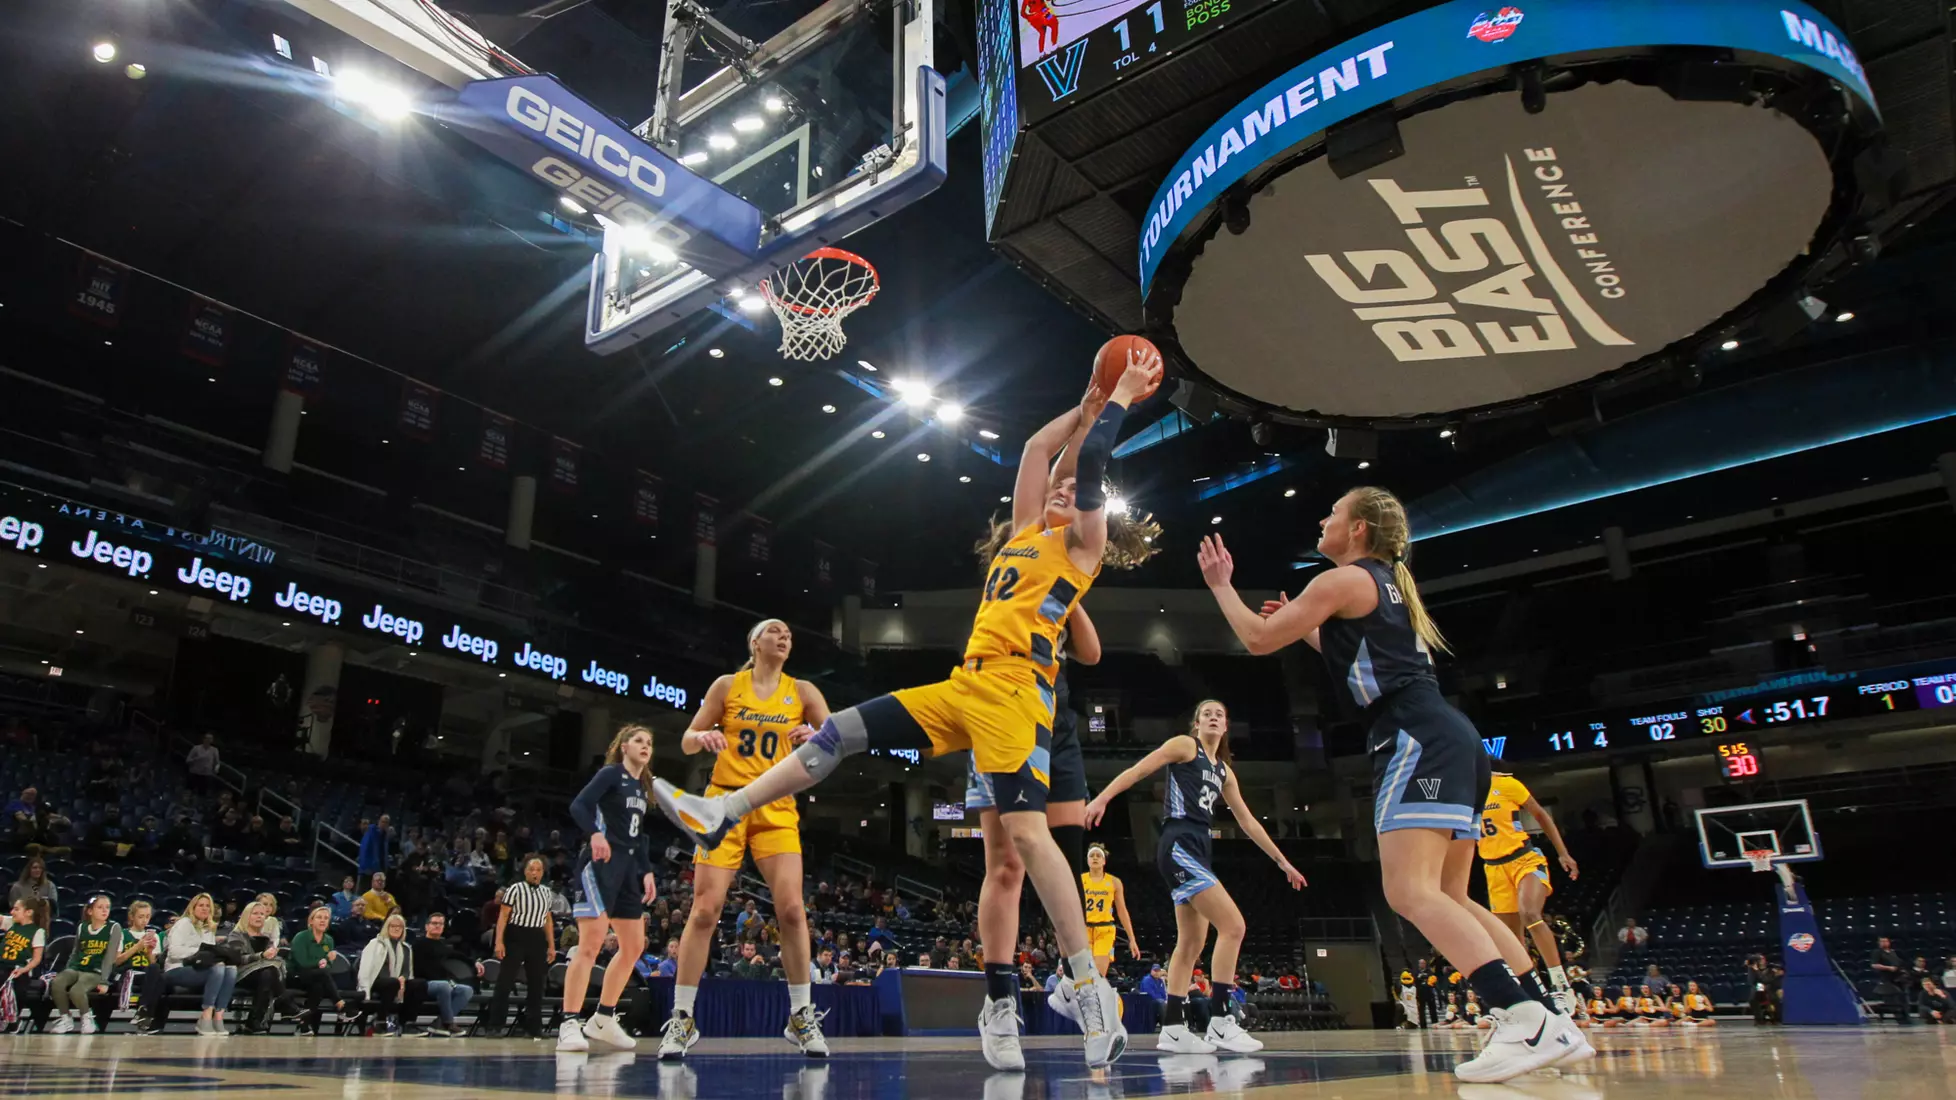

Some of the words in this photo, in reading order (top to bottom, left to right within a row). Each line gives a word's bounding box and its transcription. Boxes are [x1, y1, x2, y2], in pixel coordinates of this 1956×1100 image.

[1113, 52, 1140, 71] TOL
[1149, 42, 1157, 53] 4
[506, 85, 666, 198] GEICO
[1142, 40, 1394, 263] TOURNAMENT
[532, 156, 691, 247] GEICO
[1523, 146, 1626, 299] CONFERENCE
[1367, 178, 1577, 354] EAST
[76, 291, 116, 315] 1945
[1303, 249, 1487, 362] BIG
[1858, 680, 1909, 695] PERIOD
[1912, 675, 1945, 686] TEAM
[1764, 696, 1829, 723] :51.7
[1881, 693, 1895, 710] 1
[734, 707, 789, 727] Marquette
[1630, 717, 1656, 726] TEAM
[1656, 711, 1688, 722] FOULS
[1697, 707, 1724, 717] SHOT
[1650, 723, 1675, 741] 02
[1701, 716, 1727, 734] 30
[737, 728, 778, 760] 30
[1549, 731, 1574, 750] 11
[1593, 731, 1608, 747] 4
[1726, 755, 1758, 777] 30
[1086, 898, 1105, 912] 24
[132, 955, 149, 967] 25
